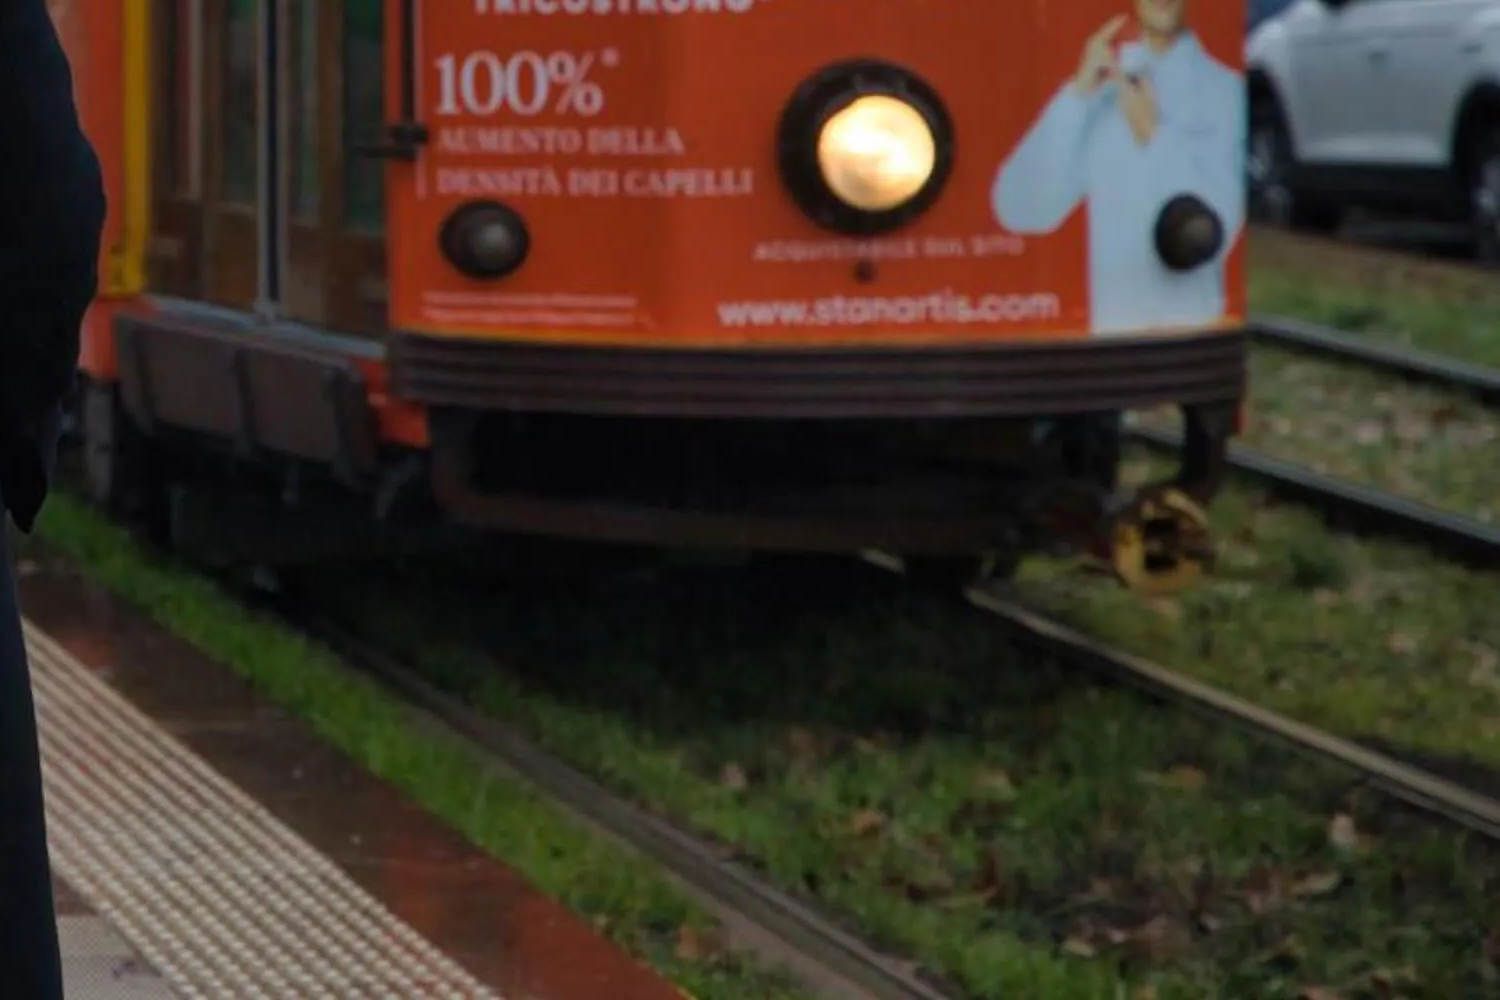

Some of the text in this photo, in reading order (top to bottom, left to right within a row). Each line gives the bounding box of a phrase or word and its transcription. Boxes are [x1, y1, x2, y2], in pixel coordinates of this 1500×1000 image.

[587, 126, 686, 155] DELLA
[567, 168, 619, 196] DEI
[622, 167, 754, 196] CAPELLI
